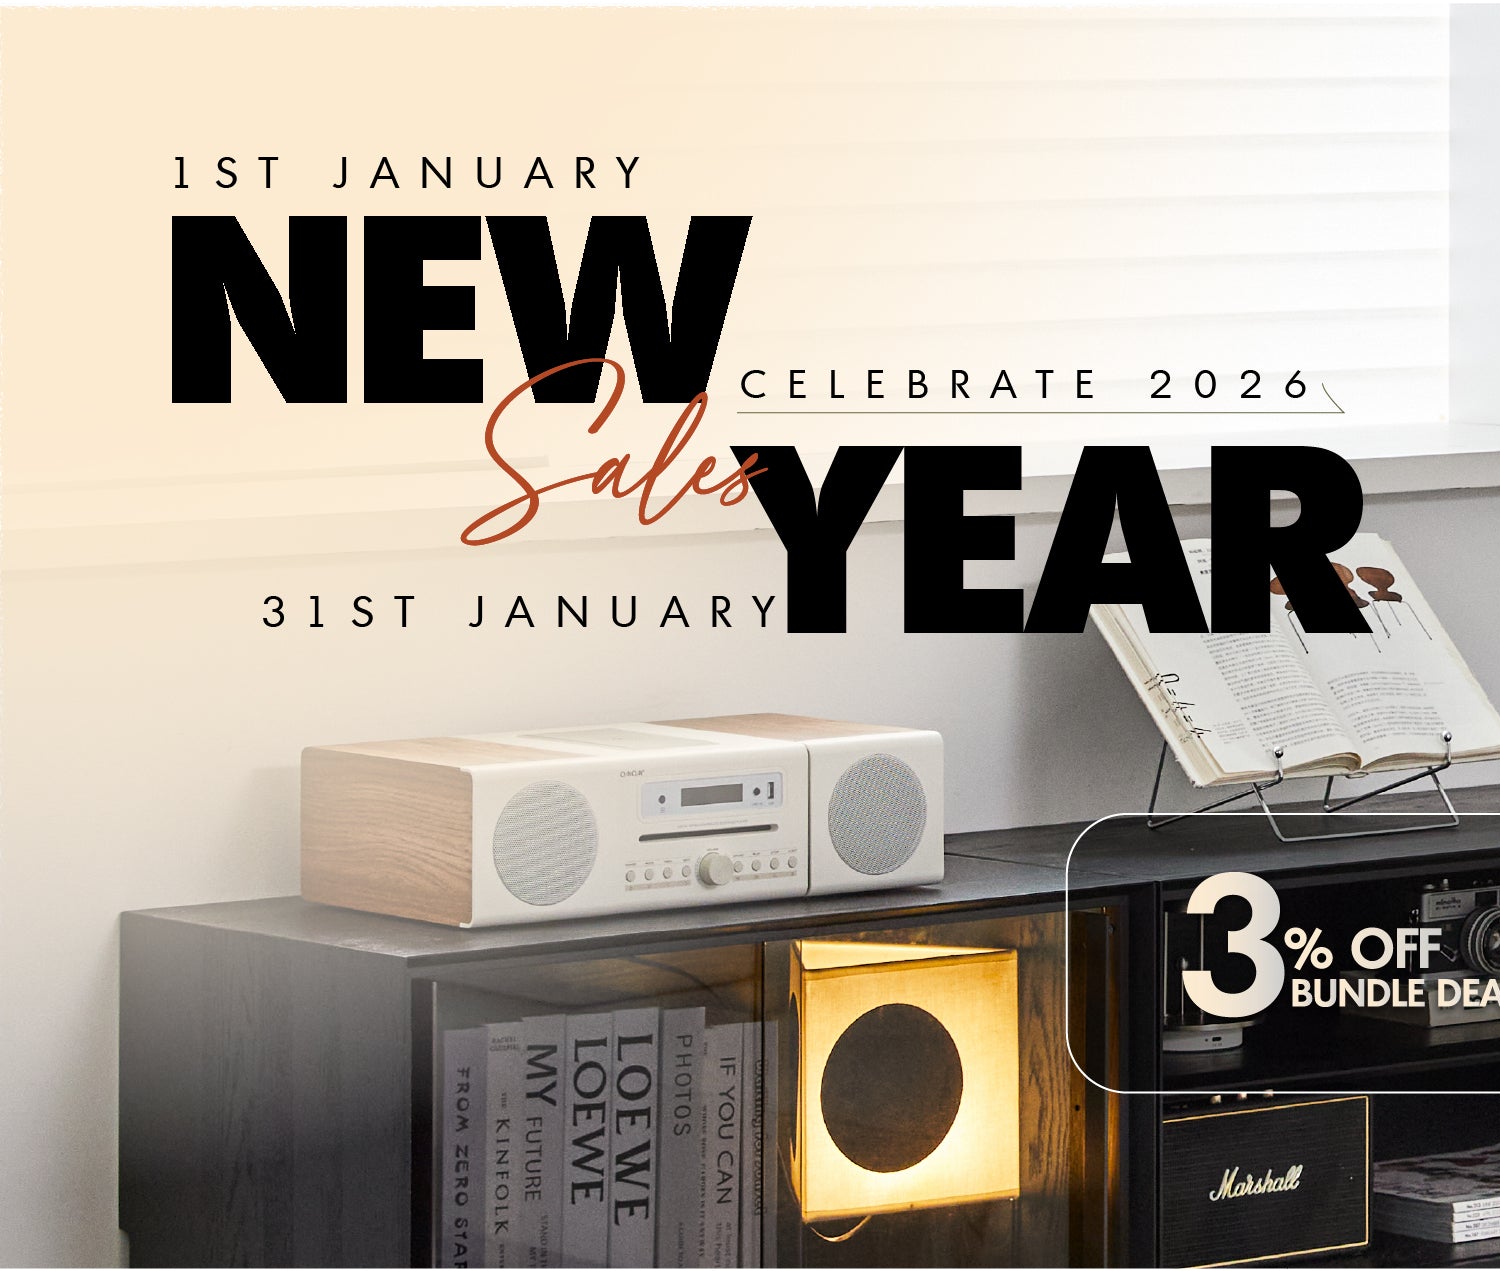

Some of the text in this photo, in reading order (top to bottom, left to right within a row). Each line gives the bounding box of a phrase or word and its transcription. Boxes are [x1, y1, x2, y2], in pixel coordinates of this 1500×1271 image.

[455, 1067, 471, 1132] FROM
[524, 1044, 558, 1202] MY FUTURE
[570, 1037, 608, 1205] LOEWE
[614, 1033, 653, 1226] LOEWE
[673, 1034, 693, 1137] PHOTOS
[716, 1056, 736, 1206] IF YOU CAN
[454, 1145, 470, 1207] ZERO
[494, 1118, 510, 1235] KINFOLK
[1209, 1164, 1304, 1202] Marshall
